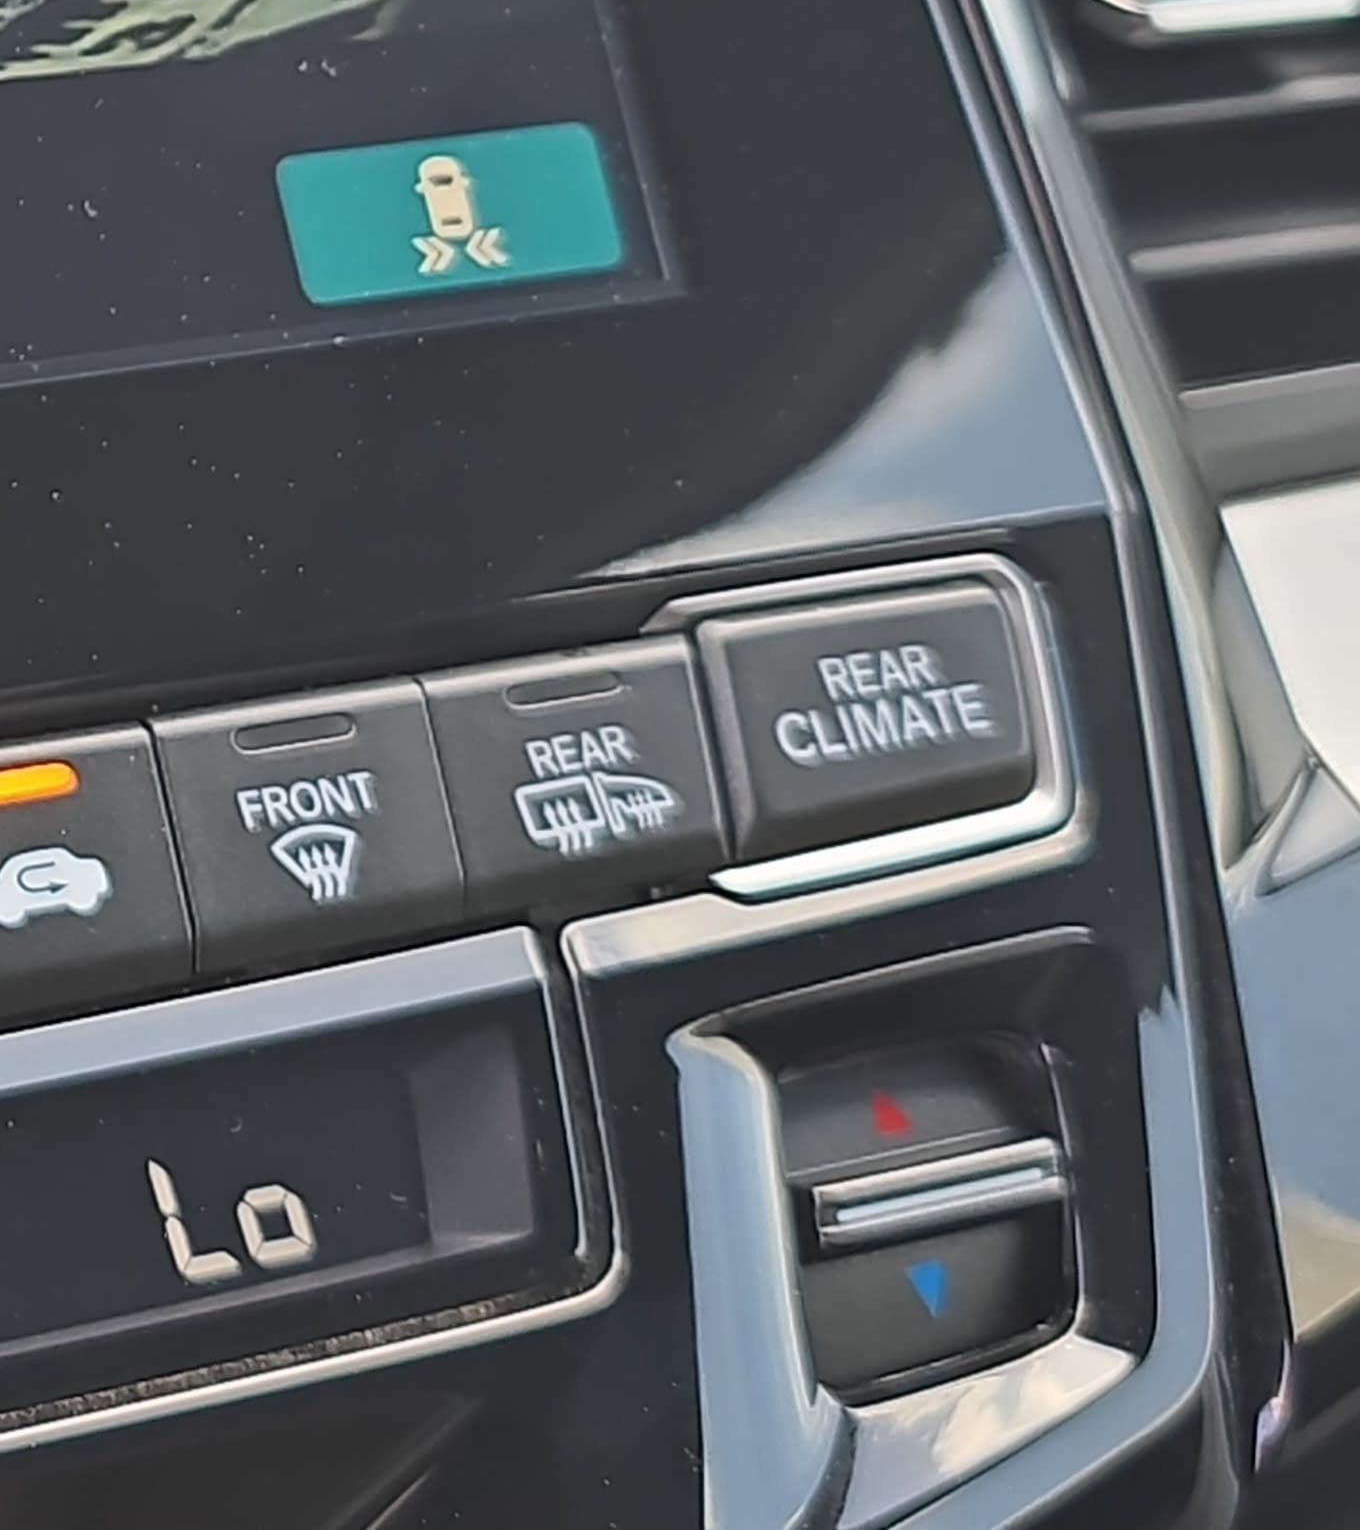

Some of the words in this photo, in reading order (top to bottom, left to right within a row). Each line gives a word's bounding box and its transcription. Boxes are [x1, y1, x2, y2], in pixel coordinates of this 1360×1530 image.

[817, 644, 940, 704] REAR
[525, 725, 632, 776] REAR
[775, 684, 997, 767] CLIMATE
[236, 770, 375, 832] FRONT
[147, 1158, 320, 1285] Lo
